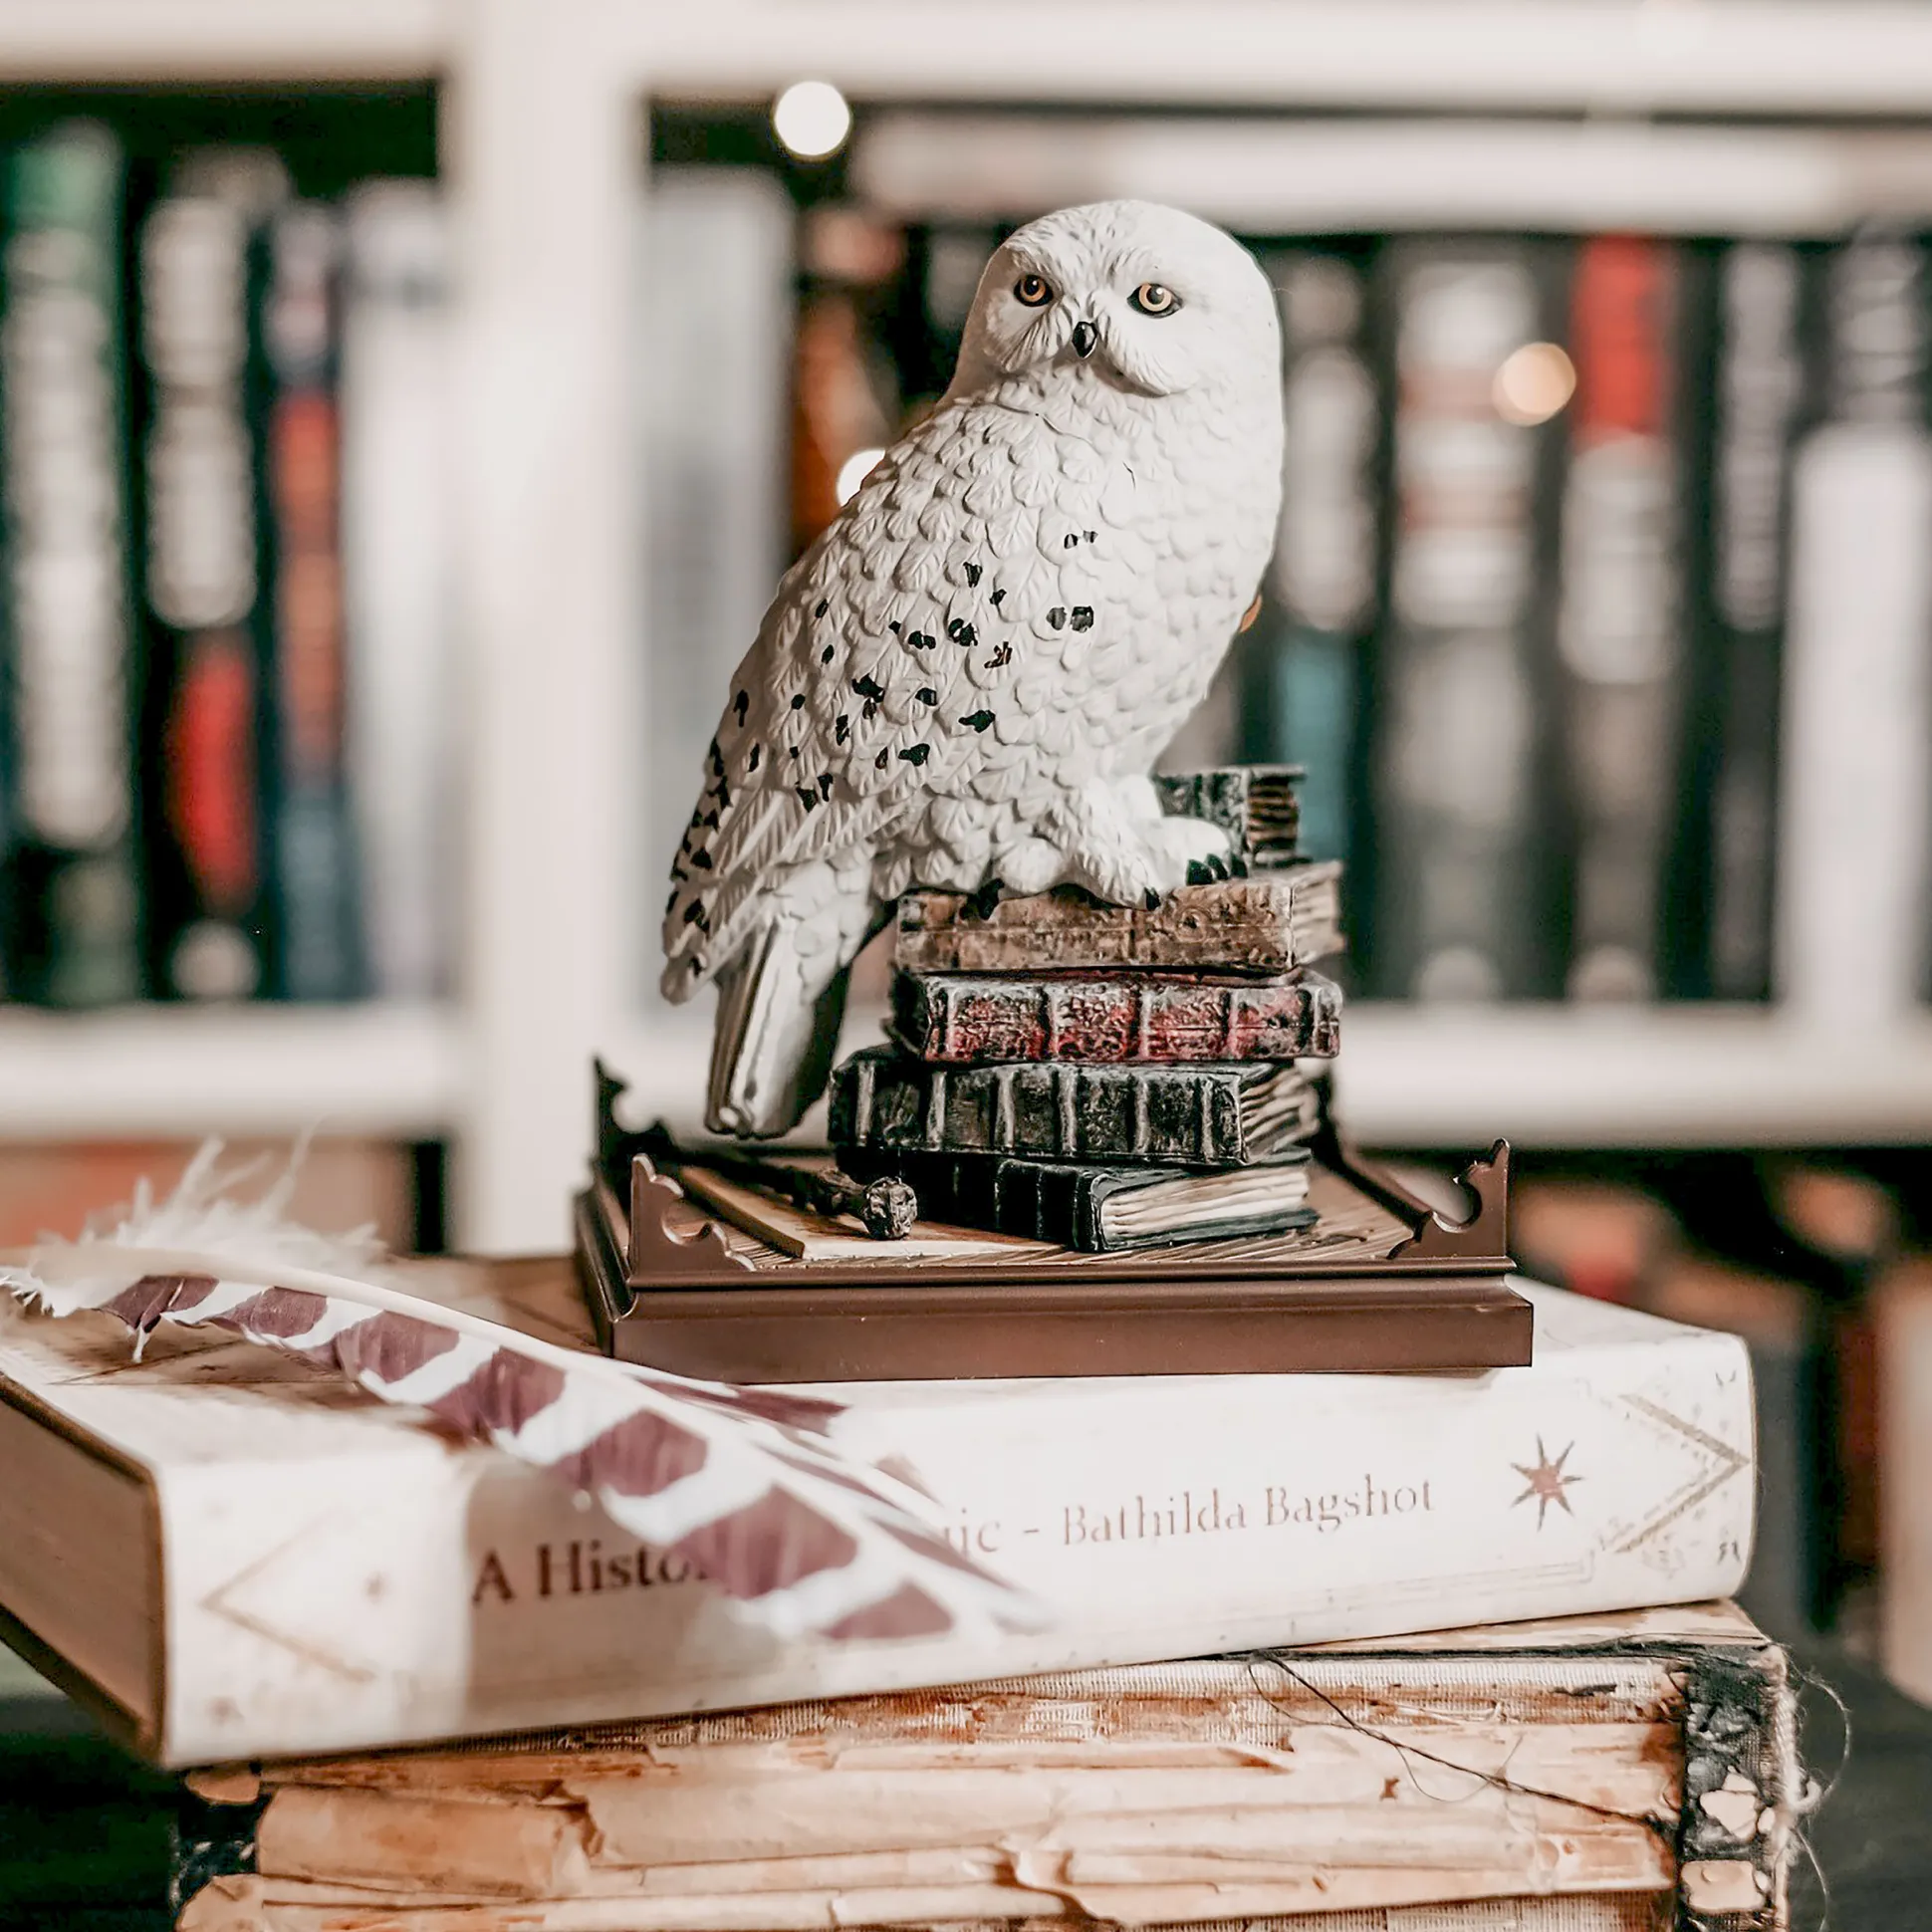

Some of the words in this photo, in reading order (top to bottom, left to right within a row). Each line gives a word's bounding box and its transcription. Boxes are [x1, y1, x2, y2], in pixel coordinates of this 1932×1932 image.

[472, 1550, 515, 1606] A
[536, 1539, 708, 1600] Histo
[1064, 1488, 1247, 1546] Bathilda
[1266, 1473, 1435, 1534] Bagshot
